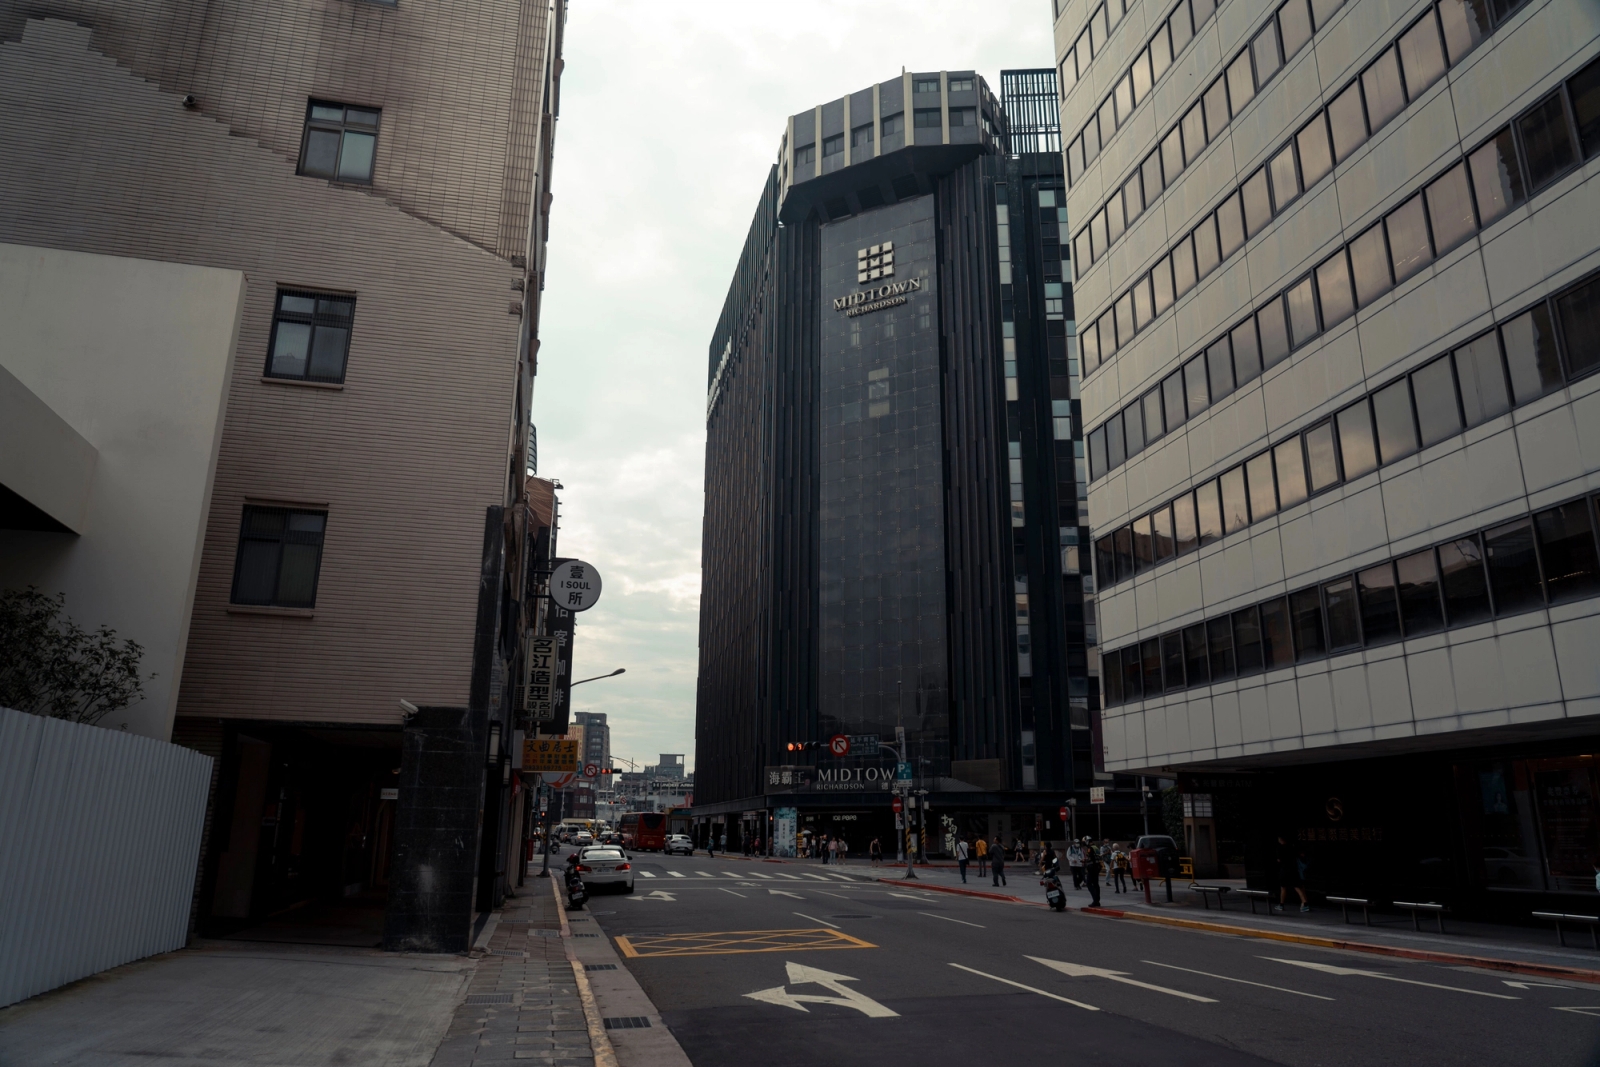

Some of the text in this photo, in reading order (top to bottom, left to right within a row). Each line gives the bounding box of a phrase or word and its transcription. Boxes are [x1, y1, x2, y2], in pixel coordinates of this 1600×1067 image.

[833, 277, 921, 311] MIDTOWN
[846, 296, 907, 317] RICHARDSON
[569, 565, 584, 579] 壹
[566, 581, 591, 590] SOUL
[568, 592, 583, 606] 所
[769, 770, 805, 786] 海霸王
[818, 767, 896, 782] MIDTOW
